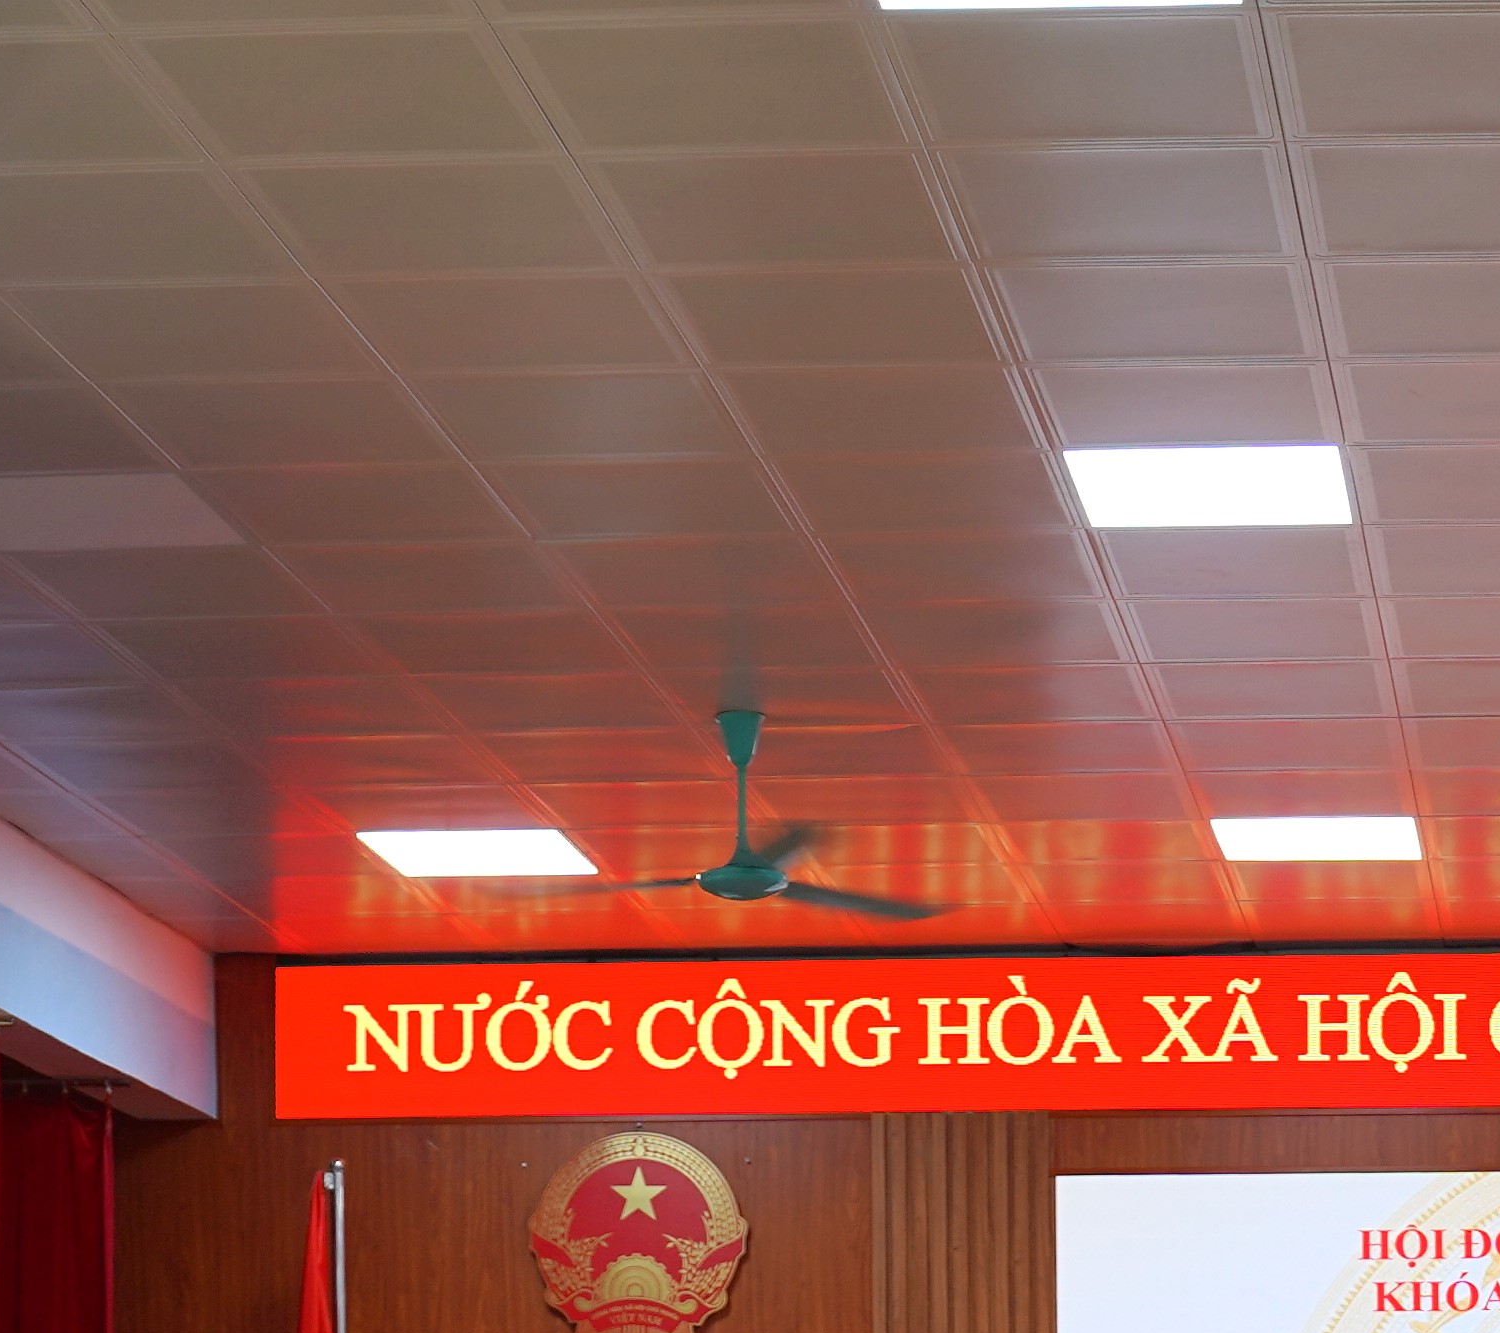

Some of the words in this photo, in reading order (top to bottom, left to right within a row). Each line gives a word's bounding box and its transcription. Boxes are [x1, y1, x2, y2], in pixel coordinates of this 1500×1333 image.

[344, 981, 612, 1072] NƯỚC
[637, 979, 900, 1079] CỘNG
[918, 976, 1121, 1065] HÒA
[1142, 978, 1278, 1062] XÃ
[1298, 972, 1466, 1073] HỘI
[1358, 1224, 1446, 1268] HỘI
